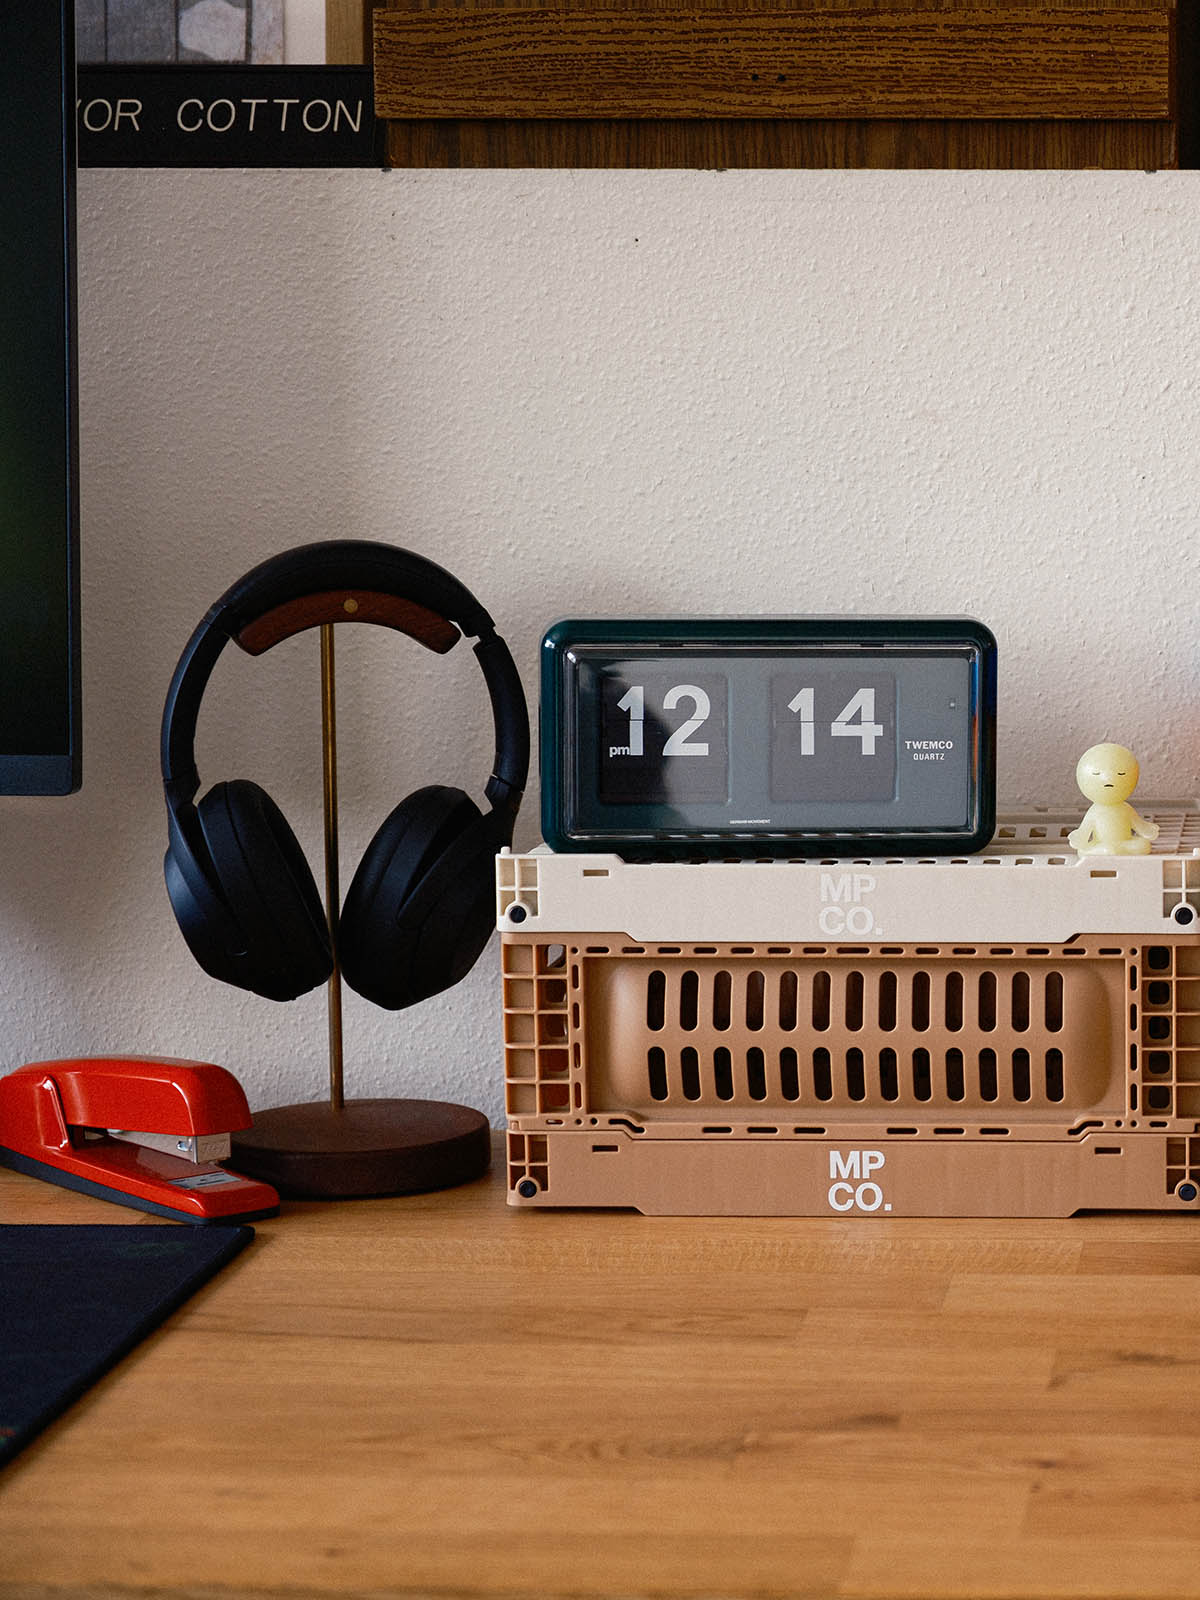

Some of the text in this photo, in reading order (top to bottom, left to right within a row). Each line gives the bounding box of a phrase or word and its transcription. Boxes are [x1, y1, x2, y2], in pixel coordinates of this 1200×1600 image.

[75, 98, 363, 132] OR COTTON
[616, 684, 711, 756] 12
[787, 687, 884, 756] 14
[609, 744, 631, 757] pm
[905, 740, 953, 750] TWEMCO
[913, 753, 945, 761] QUARTZ
[820, 873, 877, 903] MP
[818, 906, 883, 936] CO.
[829, 1150, 886, 1179] MP
[827, 1182, 893, 1212] CO.
